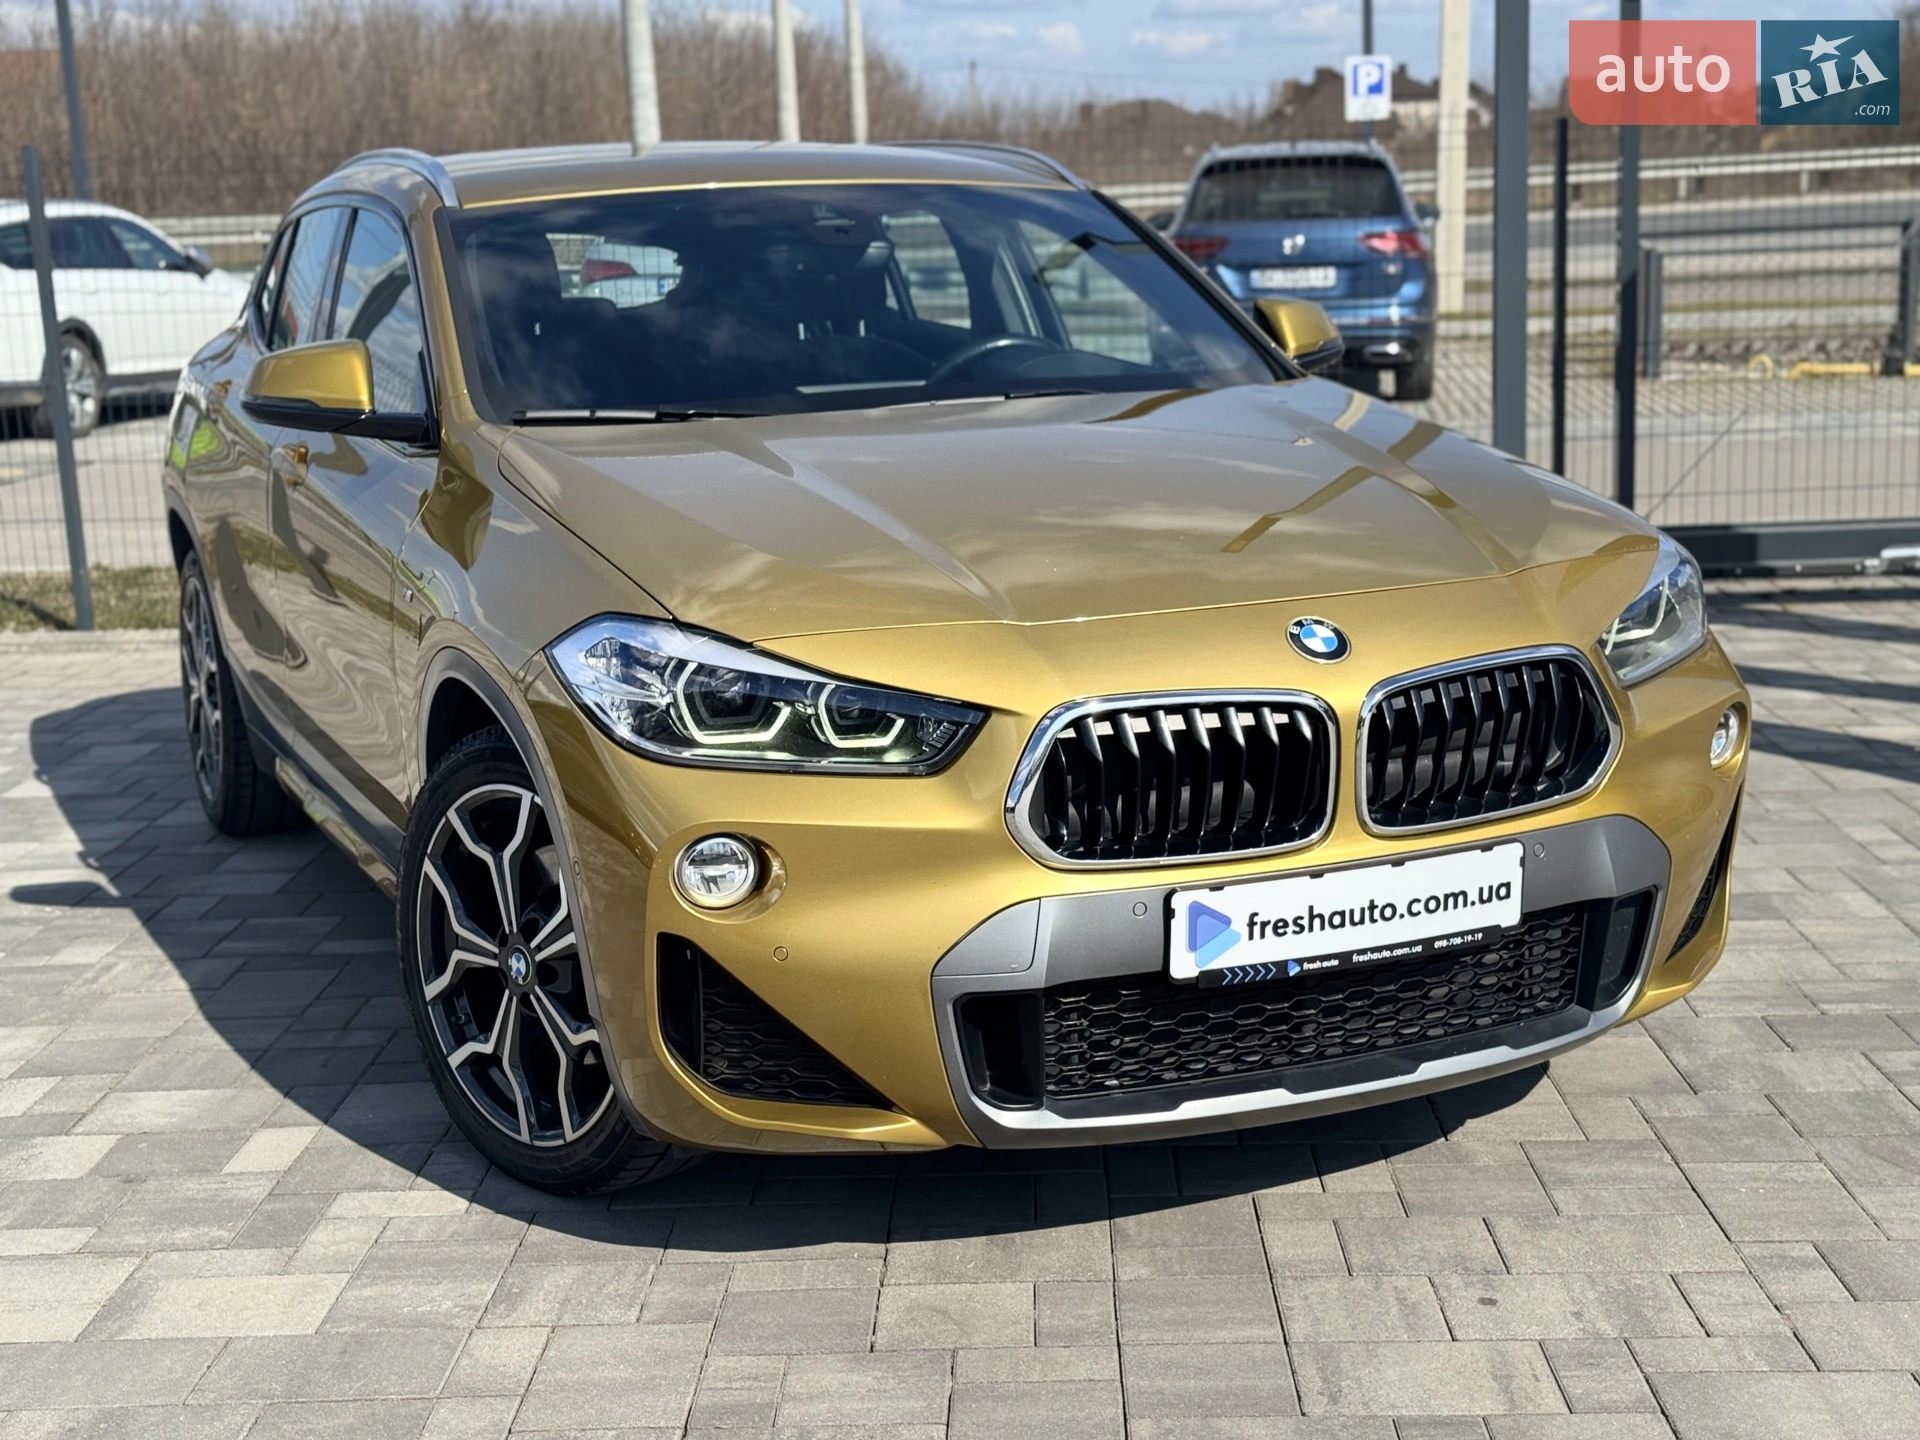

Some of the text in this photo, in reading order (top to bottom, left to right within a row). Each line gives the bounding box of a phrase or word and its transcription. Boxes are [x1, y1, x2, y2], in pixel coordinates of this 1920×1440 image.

[1246, 880, 1512, 941] freshauto.com.ua
[1433, 932, 1484, 949] 098-708-19-19
[1352, 944, 1423, 963] freshauto.com.ua
